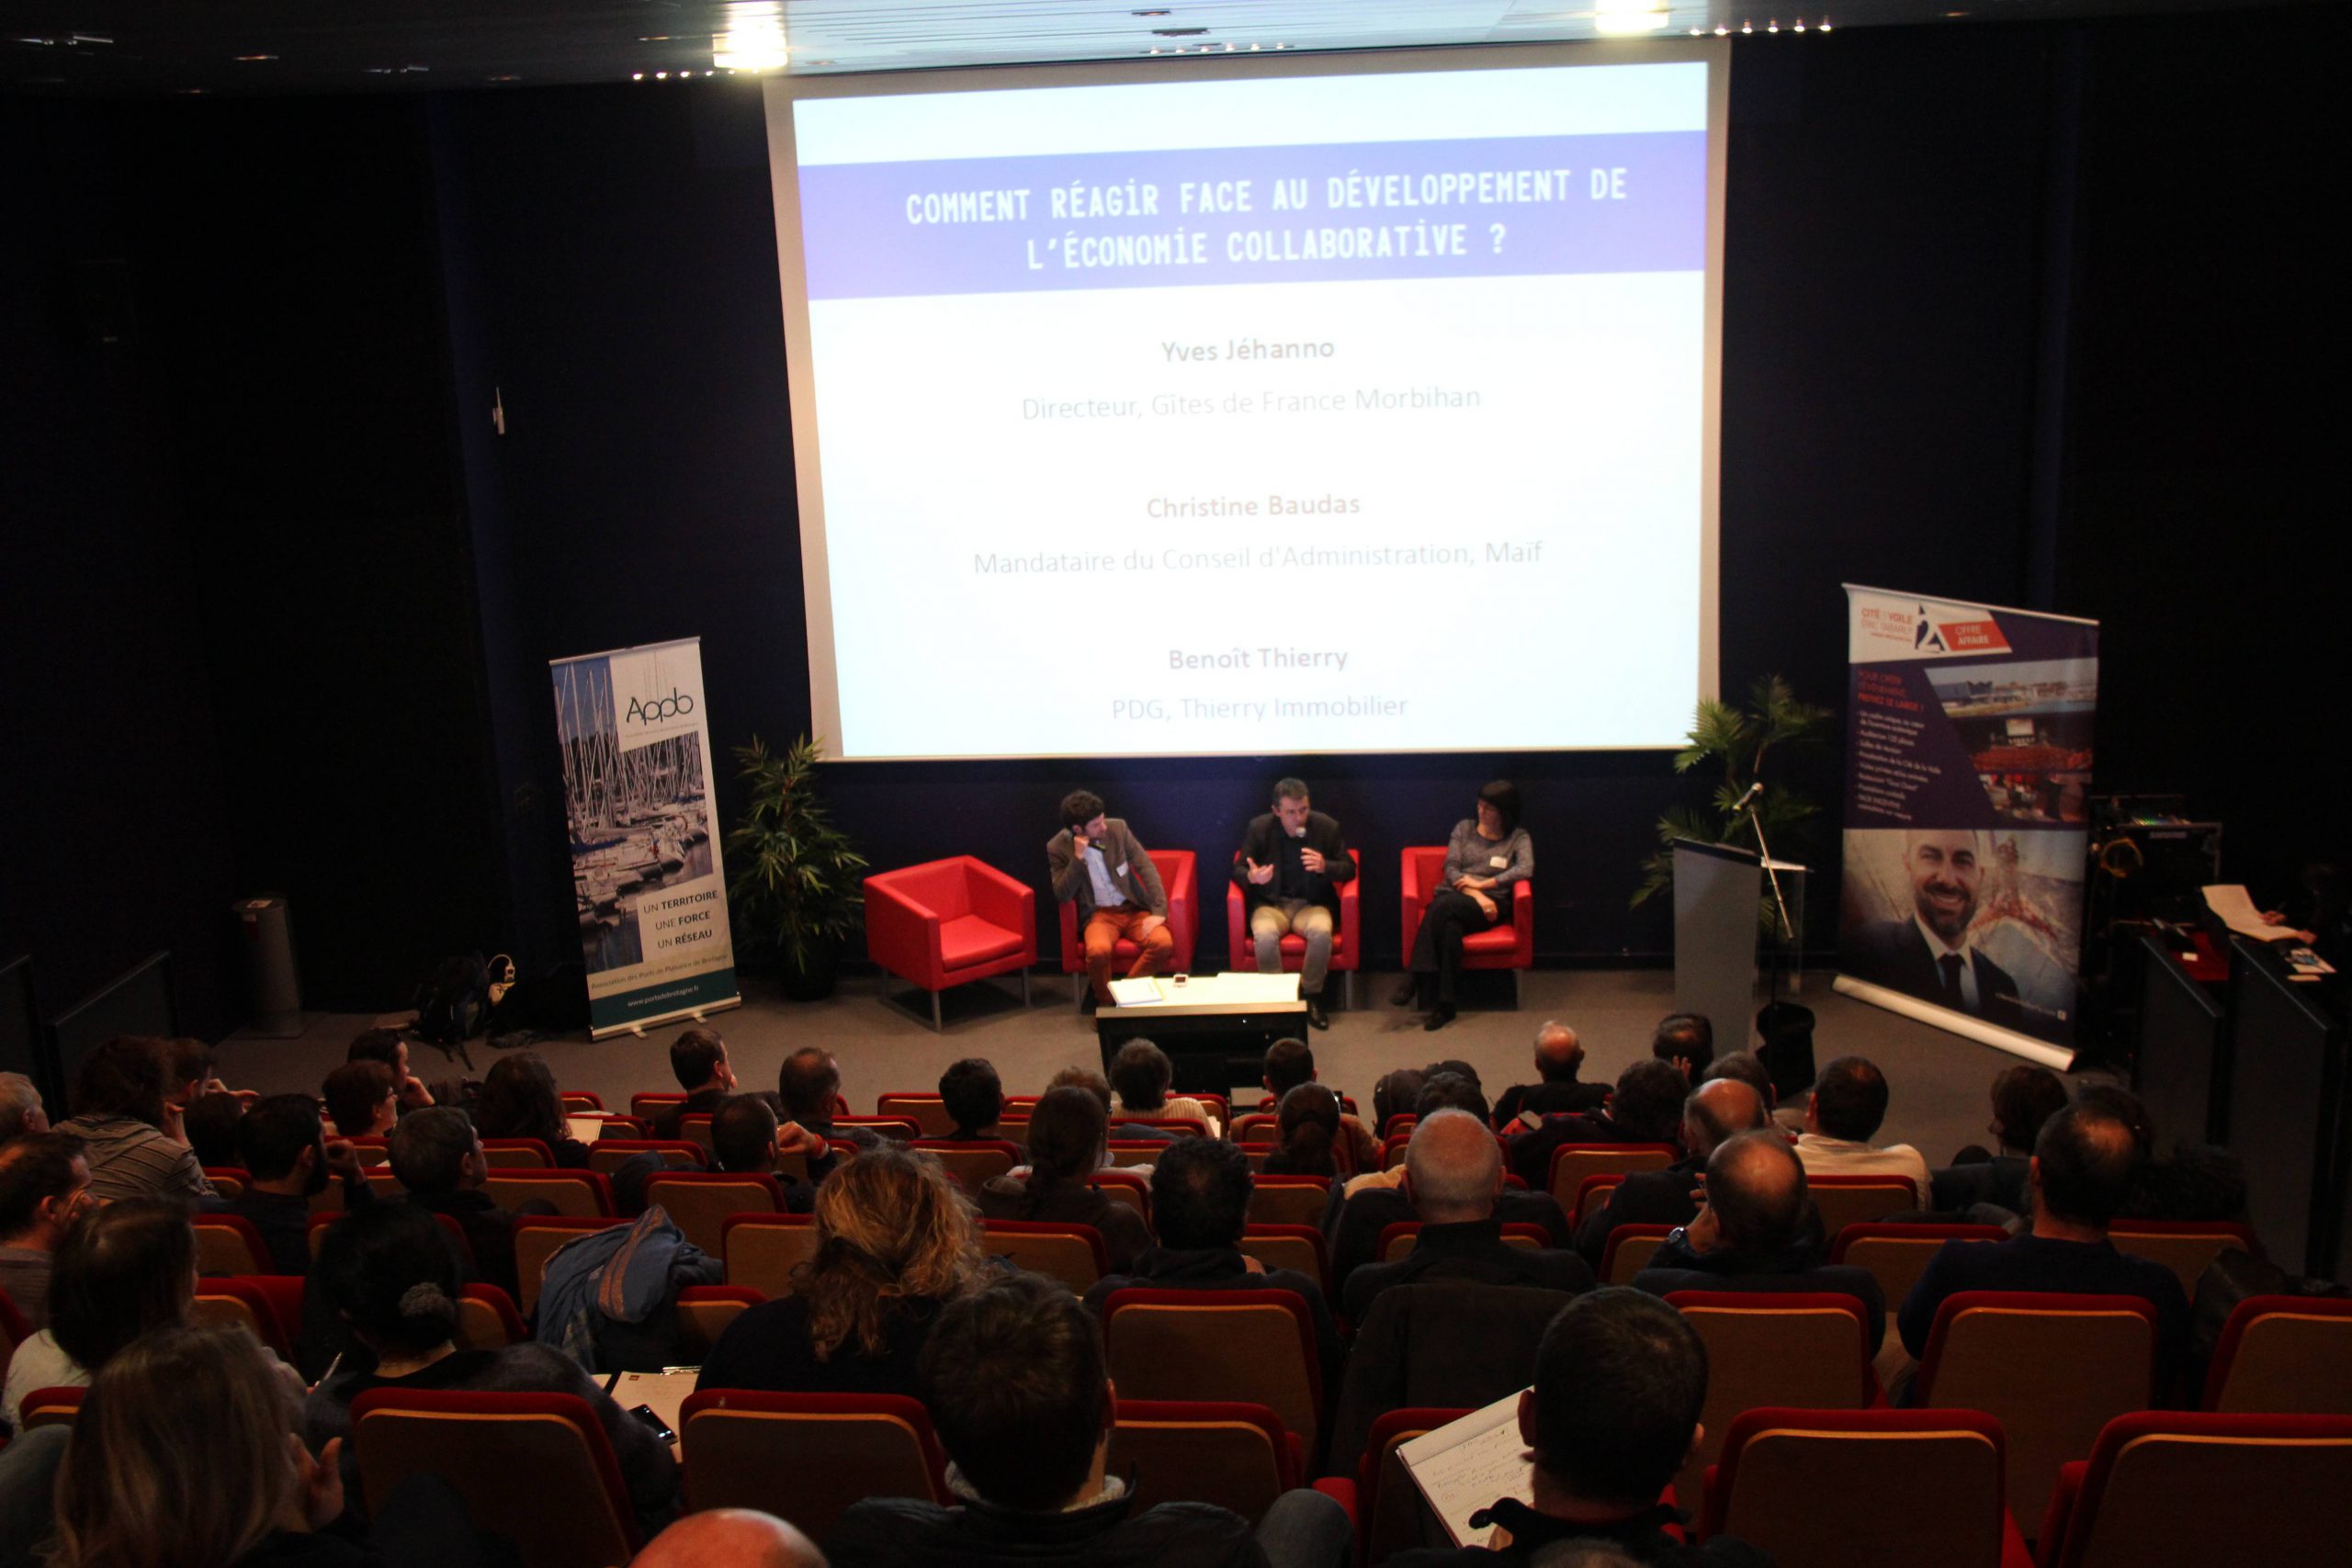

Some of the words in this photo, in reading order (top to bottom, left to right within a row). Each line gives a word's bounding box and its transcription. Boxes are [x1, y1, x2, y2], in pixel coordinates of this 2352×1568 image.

[906, 188, 1031, 223] COMMENT
[1181, 180, 1252, 213] FACE
[1273, 178, 1307, 209] AU
[1328, 168, 1571, 208] DÉVELOPPEMENT
[1591, 167, 1627, 199] DE
[1489, 222, 1506, 254] ?
[1161, 340, 1220, 363] Yves
[1225, 337, 1336, 360] Jéhanno
[1023, 397, 1142, 420] Directeur,
[1152, 393, 1214, 415] Gîtes
[1223, 392, 1253, 413] de
[1263, 391, 1345, 412] France
[1356, 386, 1483, 409] Morbihan
[1147, 495, 1259, 518] Christine
[1266, 492, 1362, 515] Baudas
[975, 551, 1115, 573] Mandataire
[1124, 549, 1154, 573] du
[1162, 547, 1250, 570] Conseil
[1260, 544, 1476, 568] d'Administration,
[1486, 540, 1544, 562] Maïf
[1954, 625, 1981, 636] OFFRE
[1957, 635, 1989, 646] AFFAIRE
[1169, 647, 1251, 670] Benoît
[1257, 647, 1350, 672] Thierry
[626, 686, 695, 727] Appb
[1113, 698, 1172, 722] PDG,
[1180, 698, 1267, 722] Thierry
[1275, 694, 1409, 718] Immobilier
[643, 903, 659, 914] UN
[662, 890, 718, 910] TERRITOIRE
[655, 918, 676, 931] UNE
[678, 910, 711, 927] FORCE
[657, 938, 673, 949] UN
[675, 929, 713, 945] RÉSEAU
